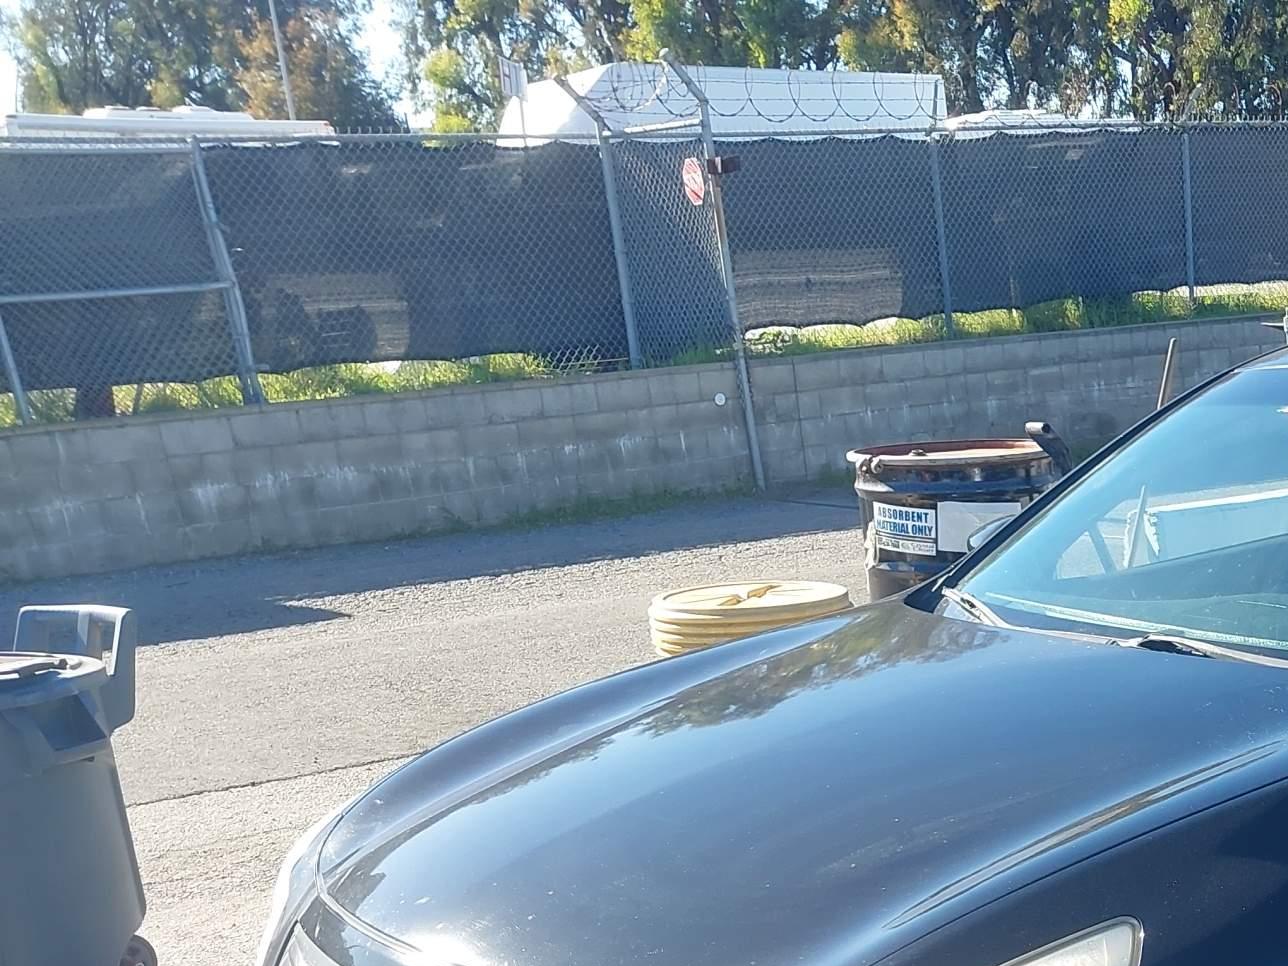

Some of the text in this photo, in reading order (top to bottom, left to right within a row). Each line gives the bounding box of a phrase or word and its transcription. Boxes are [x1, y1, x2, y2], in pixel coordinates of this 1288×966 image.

[877, 506, 929, 523] ABSORBENT
[876, 519, 933, 537] MATERIAL ONLY
